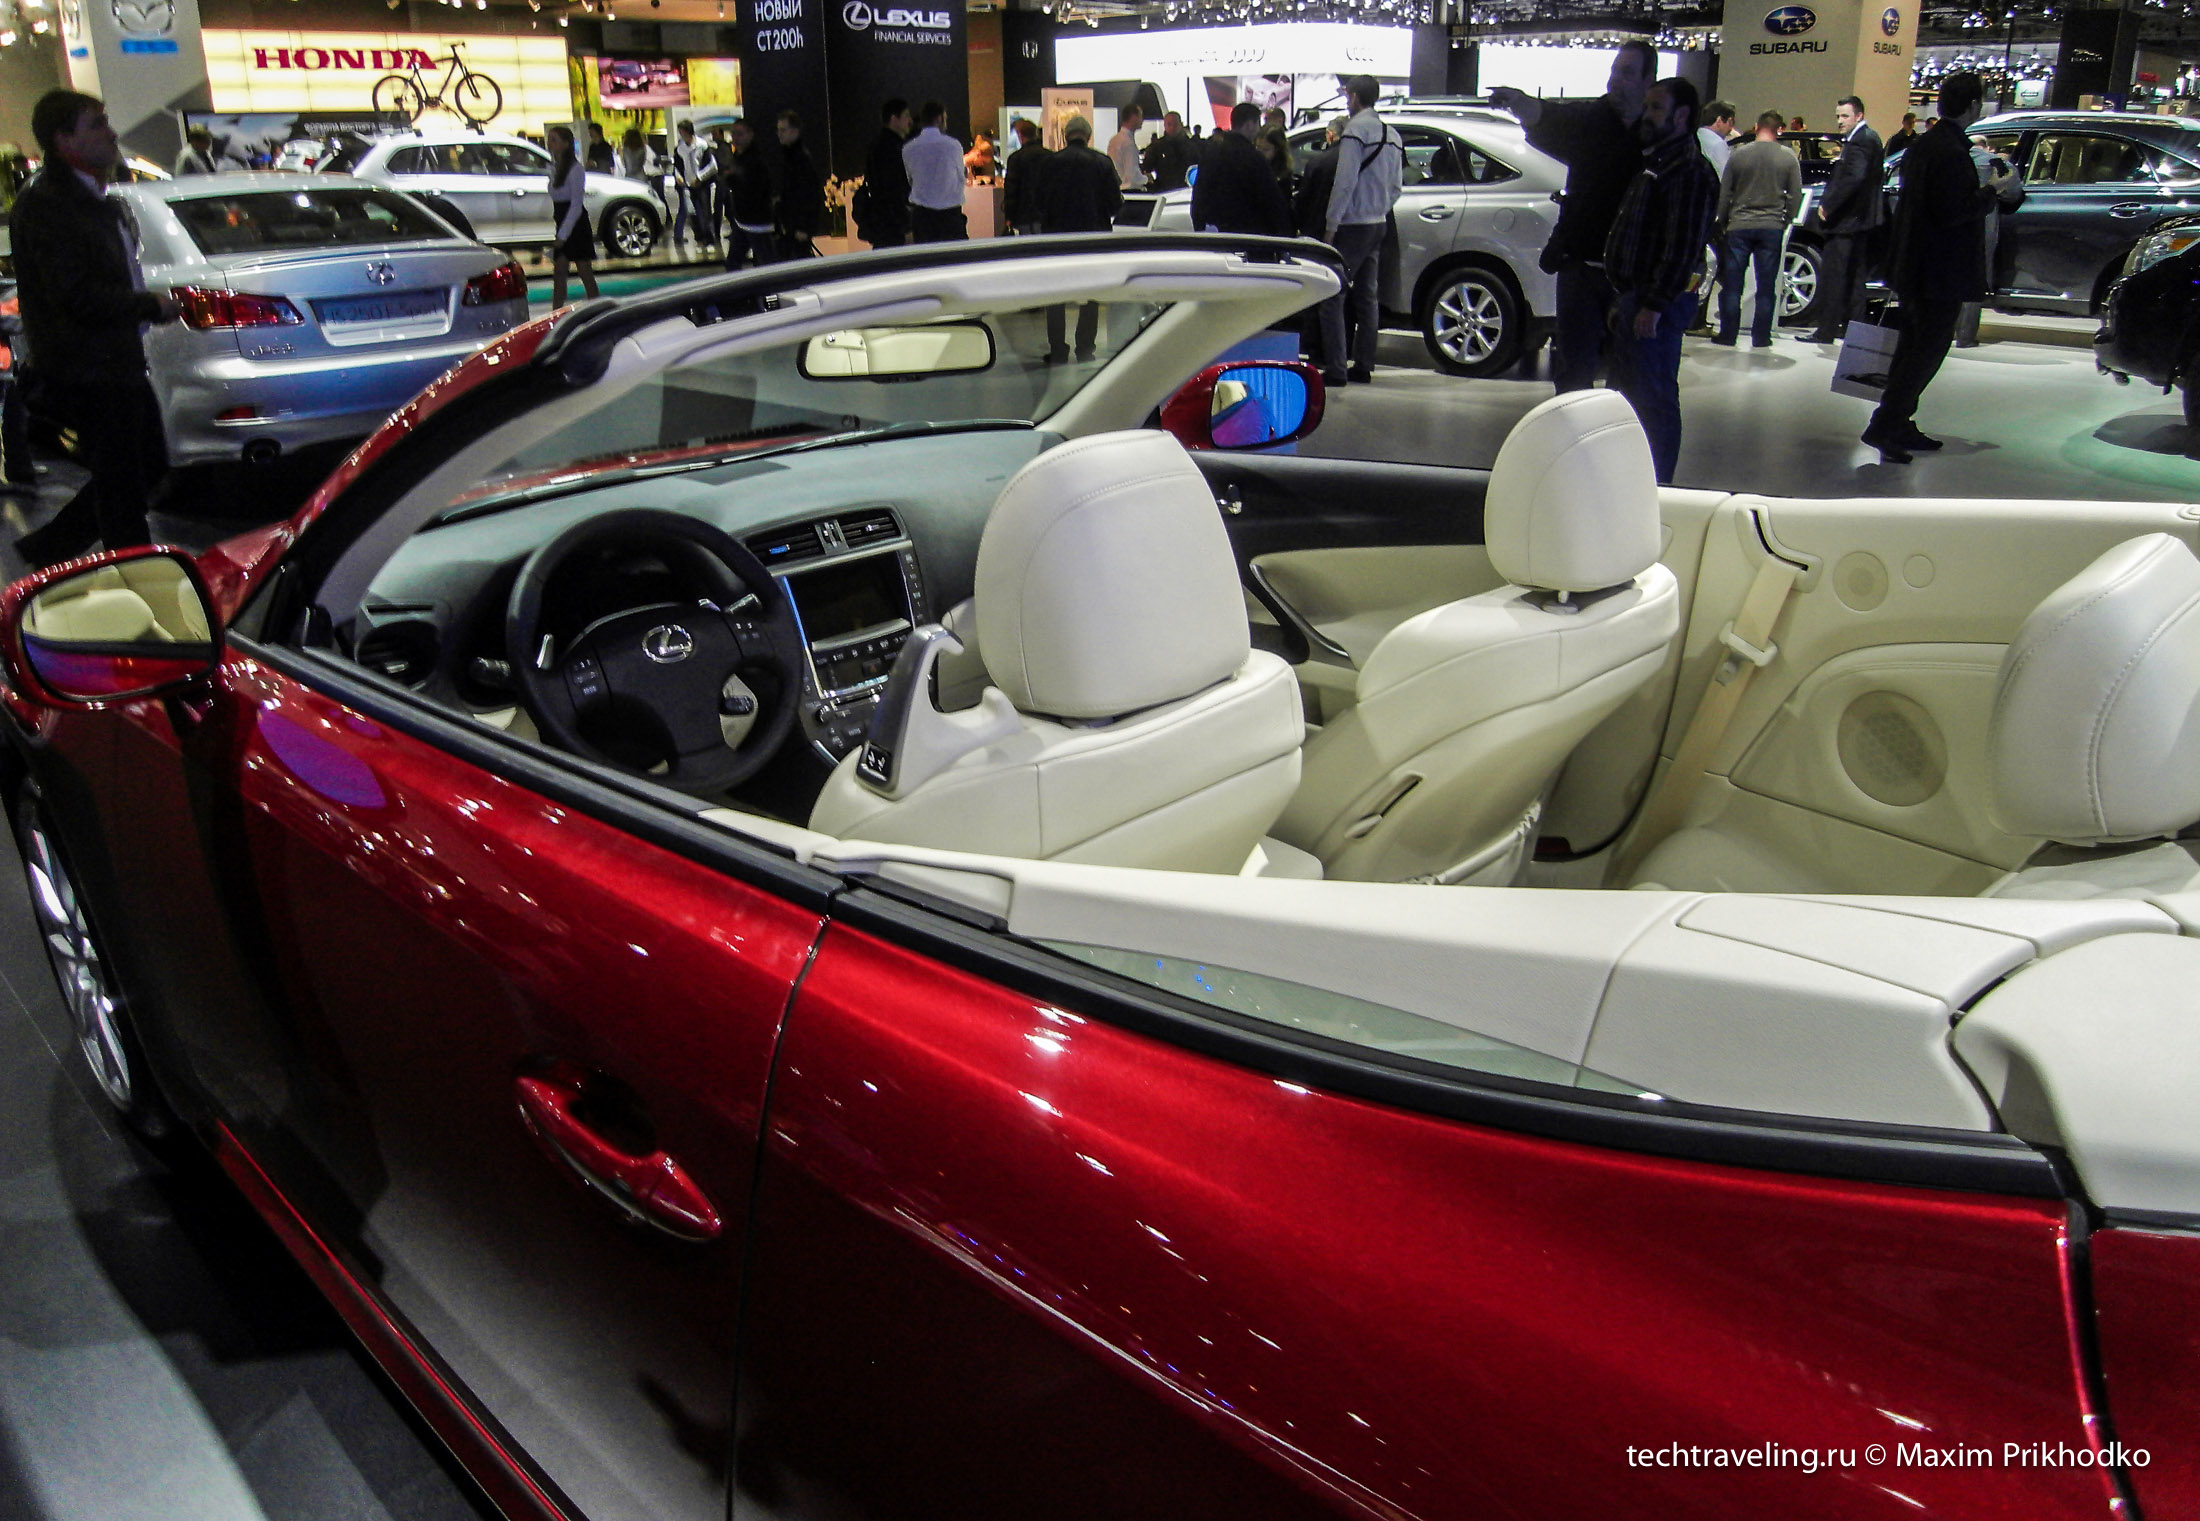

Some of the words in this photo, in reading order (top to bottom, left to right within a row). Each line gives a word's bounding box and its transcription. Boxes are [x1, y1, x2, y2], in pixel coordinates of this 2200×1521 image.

[874, 8, 951, 29] LEXUS
[874, 30, 916, 43] FINANCIAL
[917, 31, 952, 46] SERVICES
[1749, 40, 1828, 55] SUBARU
[1873, 41, 1902, 56] SUBARU
[254, 48, 437, 70] HONDA
